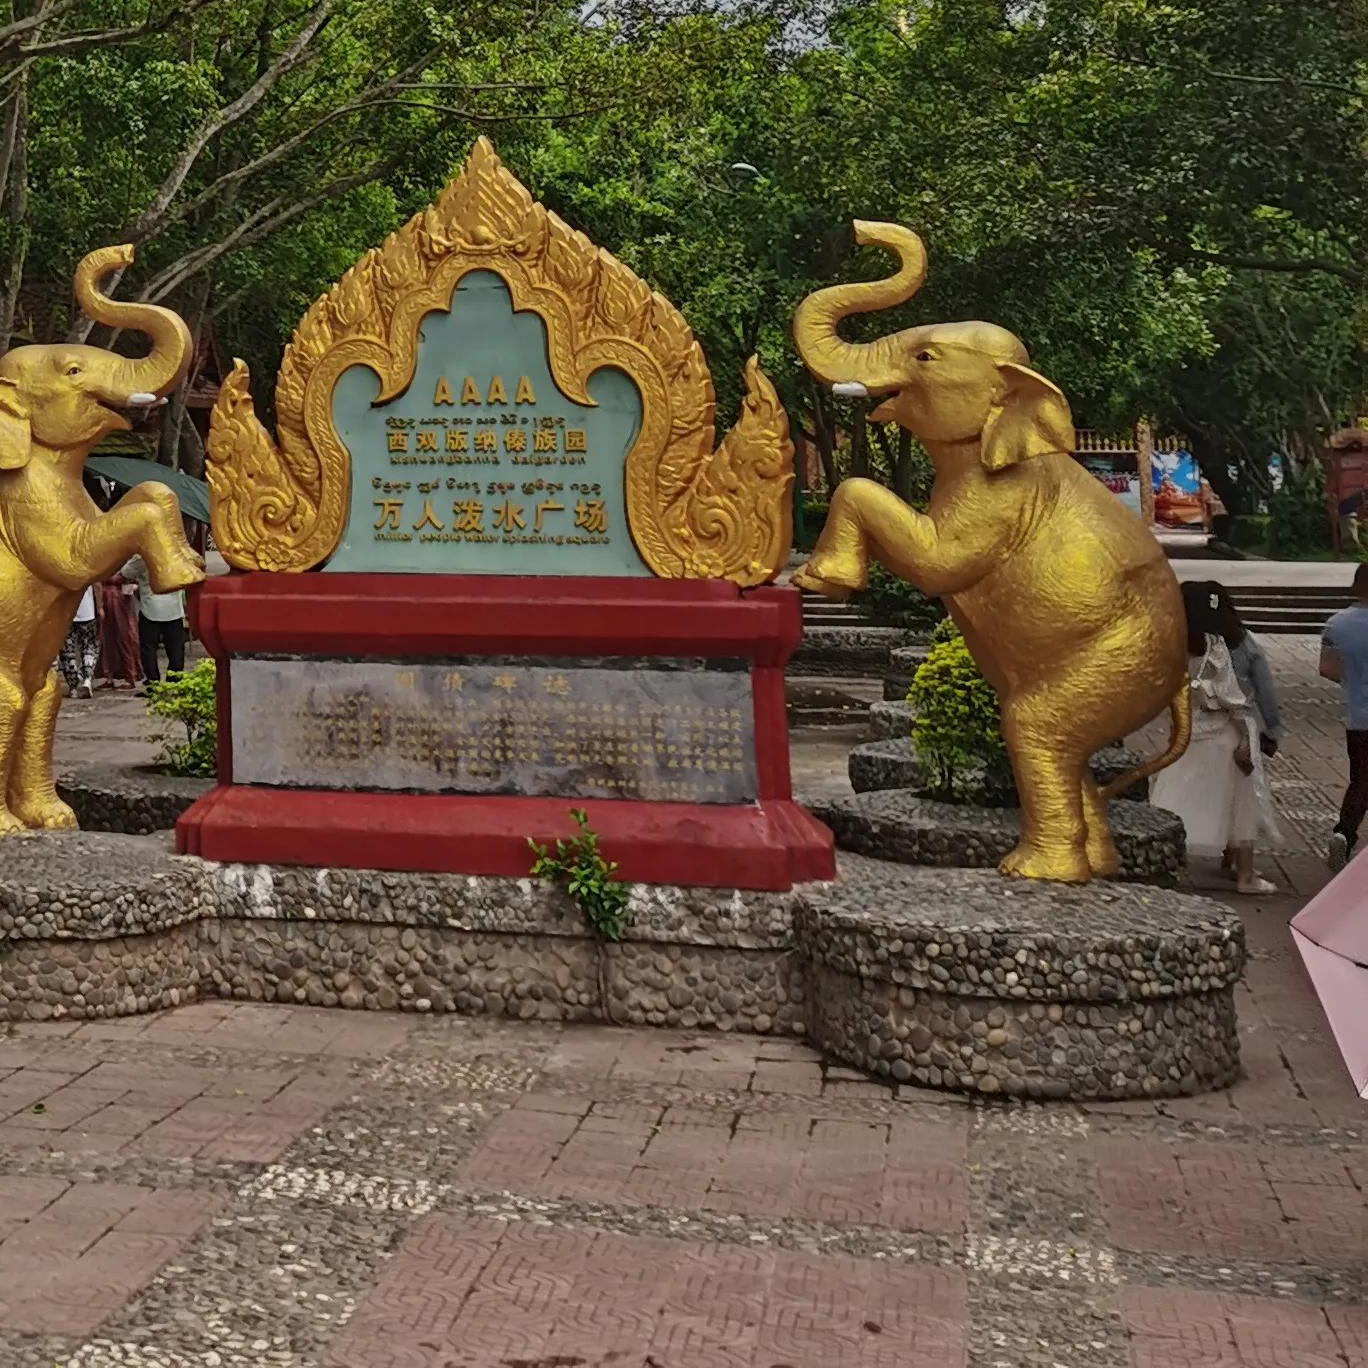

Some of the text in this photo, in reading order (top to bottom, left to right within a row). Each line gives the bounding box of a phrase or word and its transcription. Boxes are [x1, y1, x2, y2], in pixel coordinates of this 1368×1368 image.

[433, 376, 536, 406] AAAA
[387, 429, 587, 453] 西双版纳傣族园
[373, 498, 608, 533] 万人泼水广场
